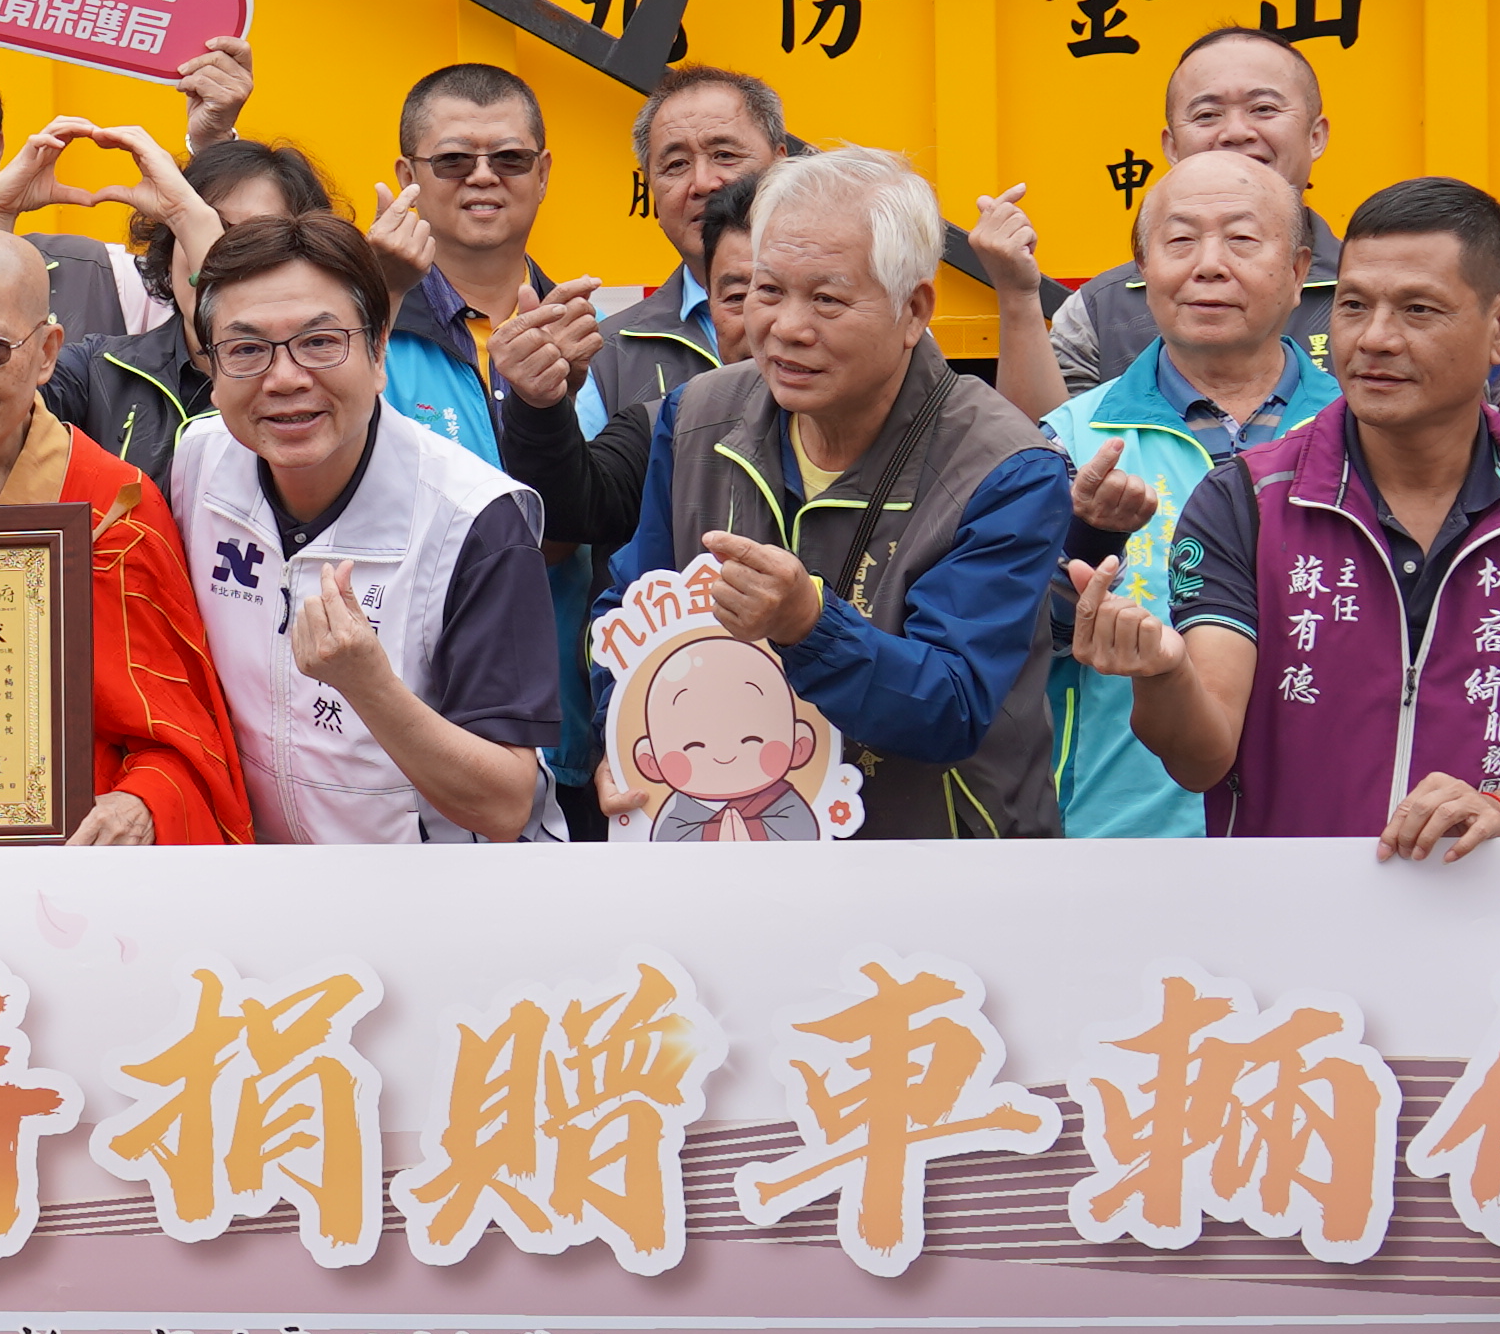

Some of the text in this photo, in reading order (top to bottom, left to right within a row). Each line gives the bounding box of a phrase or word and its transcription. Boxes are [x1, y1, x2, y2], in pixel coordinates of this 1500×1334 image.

[210, 582, 264, 606] 新北市政府
[1331, 557, 1360, 622] 主任
[1278, 554, 1332, 704] 蘇有德
